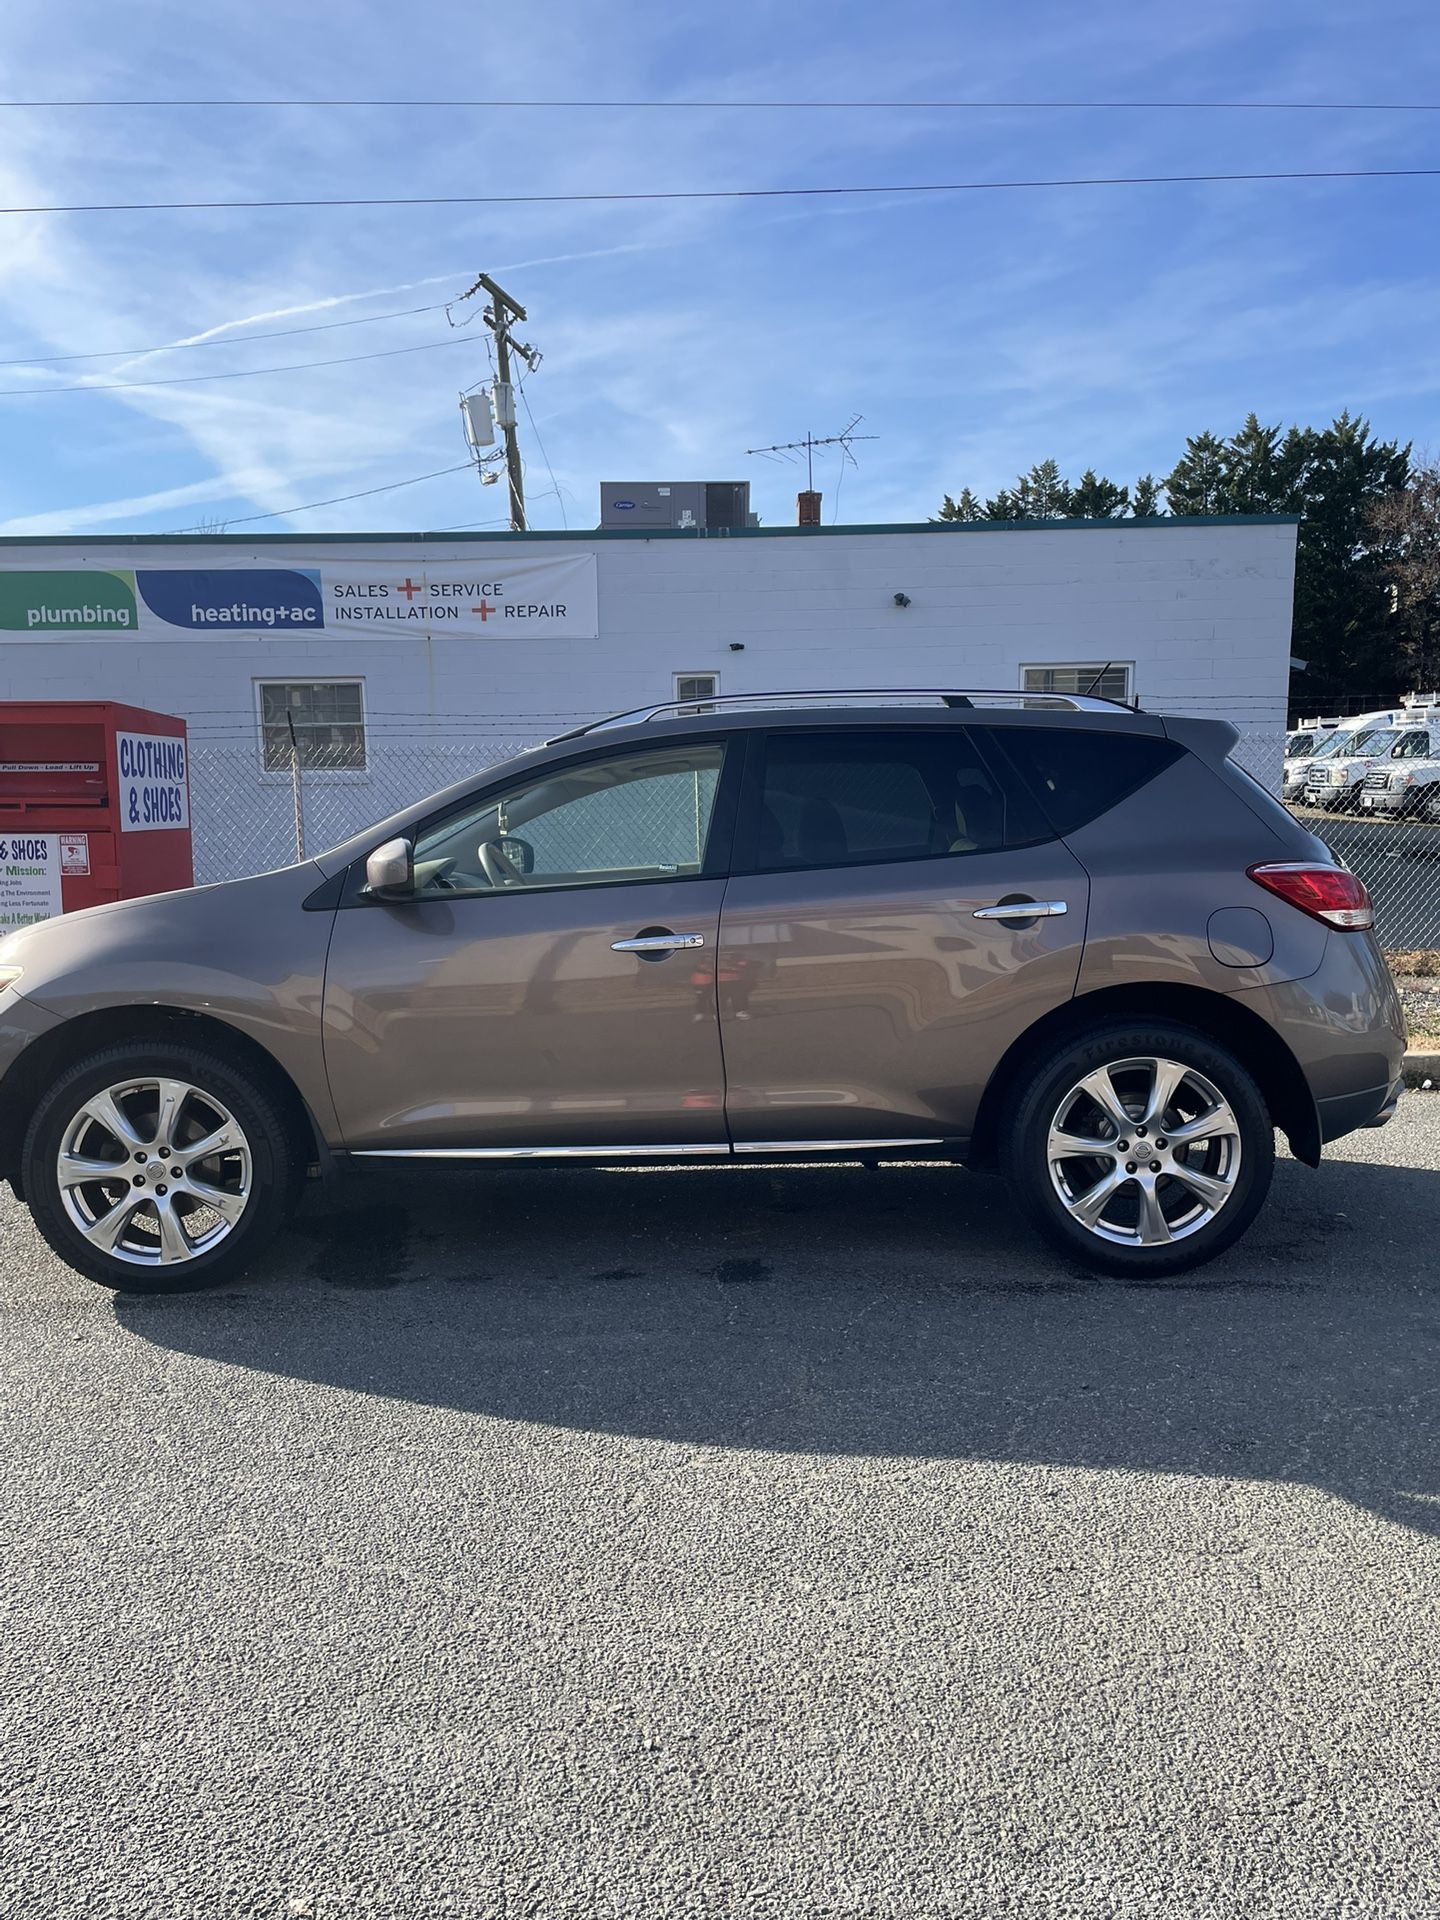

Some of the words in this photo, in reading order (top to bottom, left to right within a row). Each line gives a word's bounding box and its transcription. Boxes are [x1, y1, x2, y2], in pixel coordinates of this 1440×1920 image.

[334, 584, 389, 598] SALES
[430, 583, 503, 597] SERVICE
[27, 604, 130, 627] plumbing
[191, 603, 317, 626] heating+ac
[335, 606, 459, 620] INSTALLATION
[504, 605, 567, 618] REPAIR
[120, 738, 184, 780] CLOTHING
[129, 786, 140, 824] &
[143, 786, 182, 823] SHOES
[11, 839, 48, 861] SHOES
[61, 835, 86, 845] WARNING
[5, 865, 47, 876] Mission:
